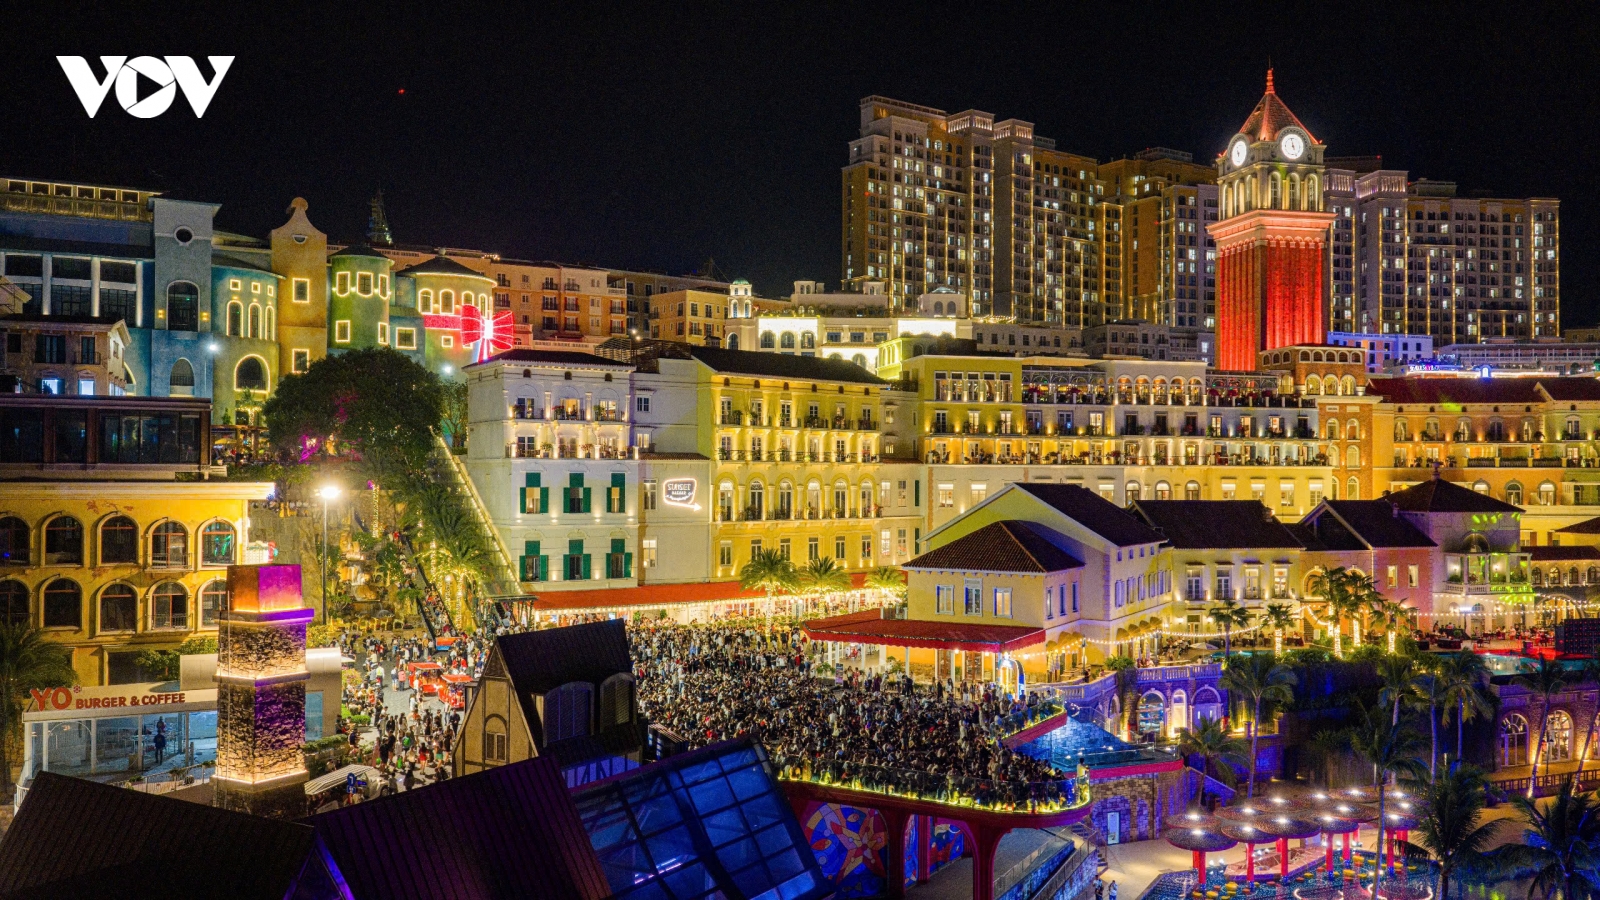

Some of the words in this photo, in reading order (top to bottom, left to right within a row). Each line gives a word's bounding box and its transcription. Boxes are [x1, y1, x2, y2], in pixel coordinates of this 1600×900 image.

[667, 483, 692, 491] SUNSET
[30, 686, 73, 712] YO
[76, 695, 127, 709] BURGER
[130, 695, 140, 706] &
[141, 693, 186, 706] COFFEE
